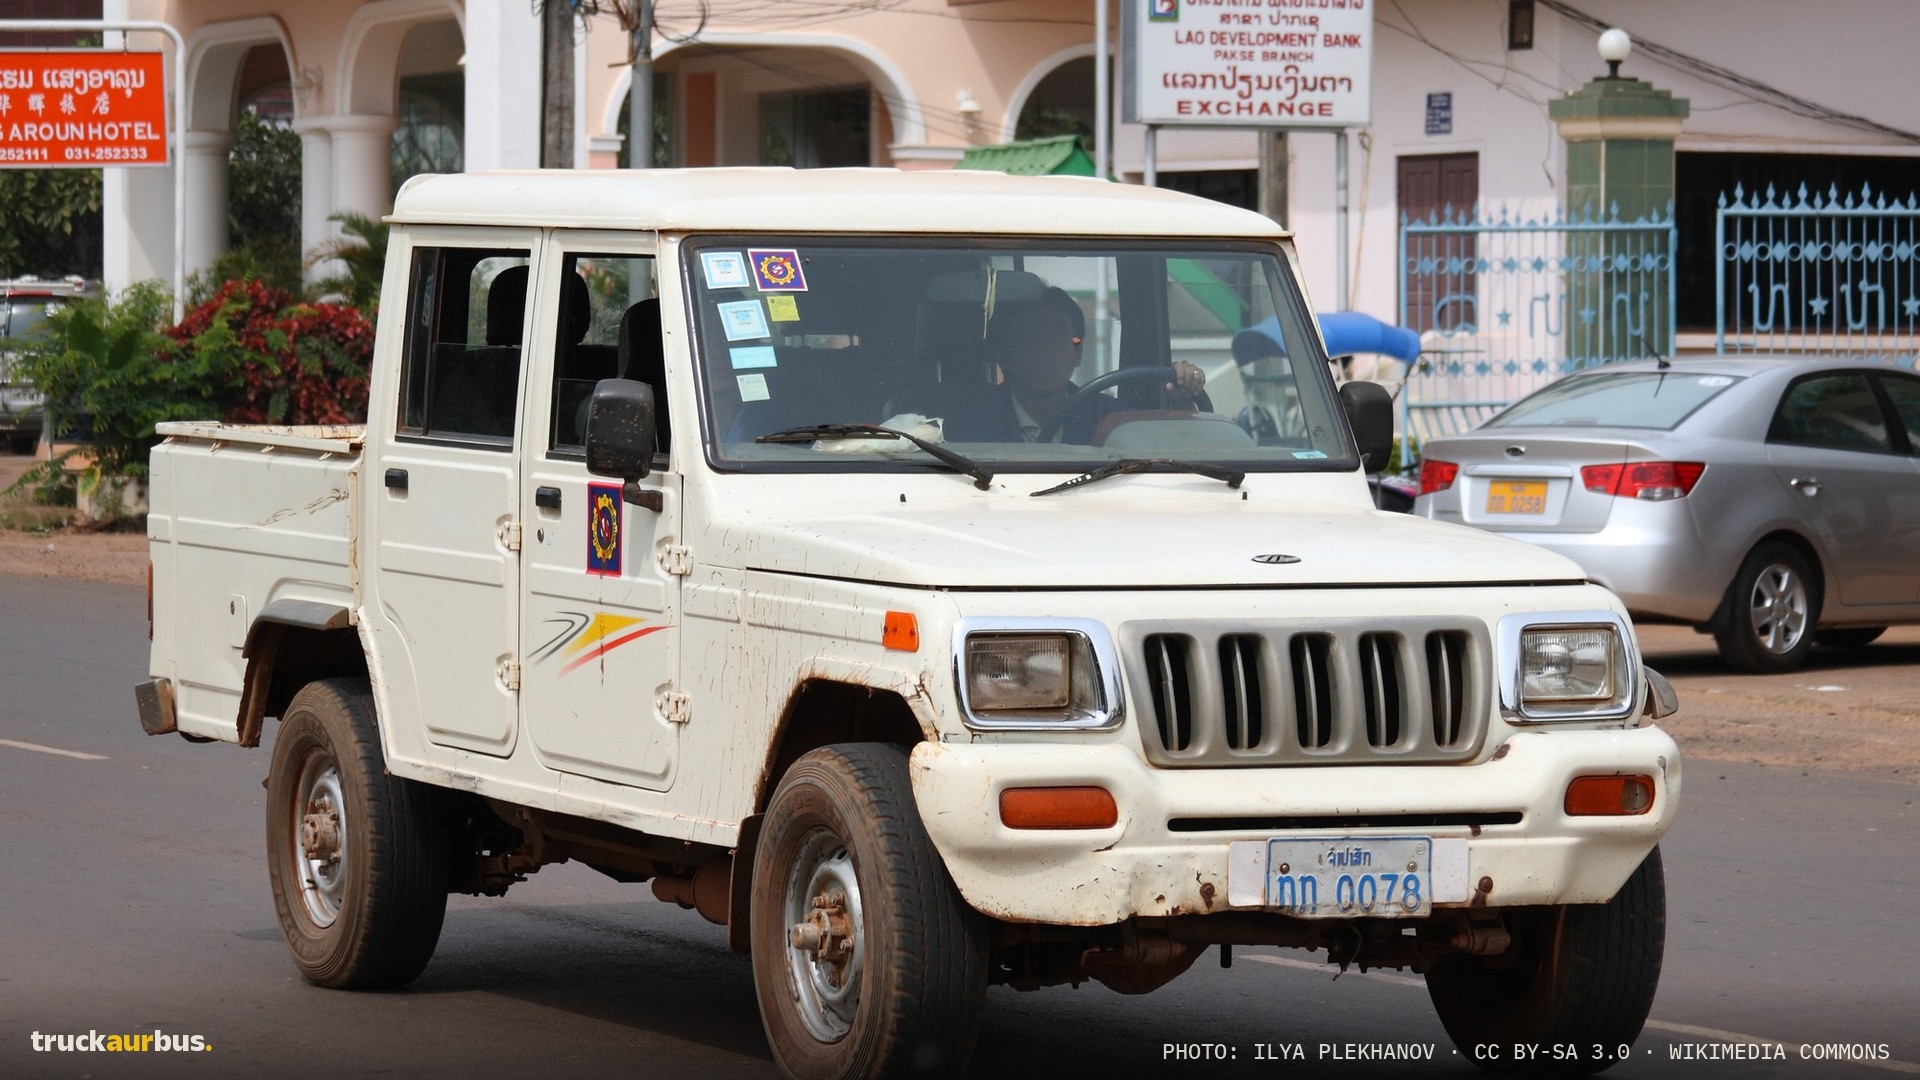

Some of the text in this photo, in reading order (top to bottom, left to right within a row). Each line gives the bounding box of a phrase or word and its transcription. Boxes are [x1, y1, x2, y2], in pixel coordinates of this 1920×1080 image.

[1175, 30, 1361, 47] LAO DEVELOPMENT BANK
[1214, 51, 1314, 62] PAKSE BRANCH
[0, 70, 33, 89] ຮມ
[1177, 100, 1333, 116] EXCHANGE
[9, 123, 83, 141] AROUN
[89, 122, 160, 140] HOTEL
[65, 147, 147, 160] 031-252333
[1336, 873, 1421, 912] 0078
